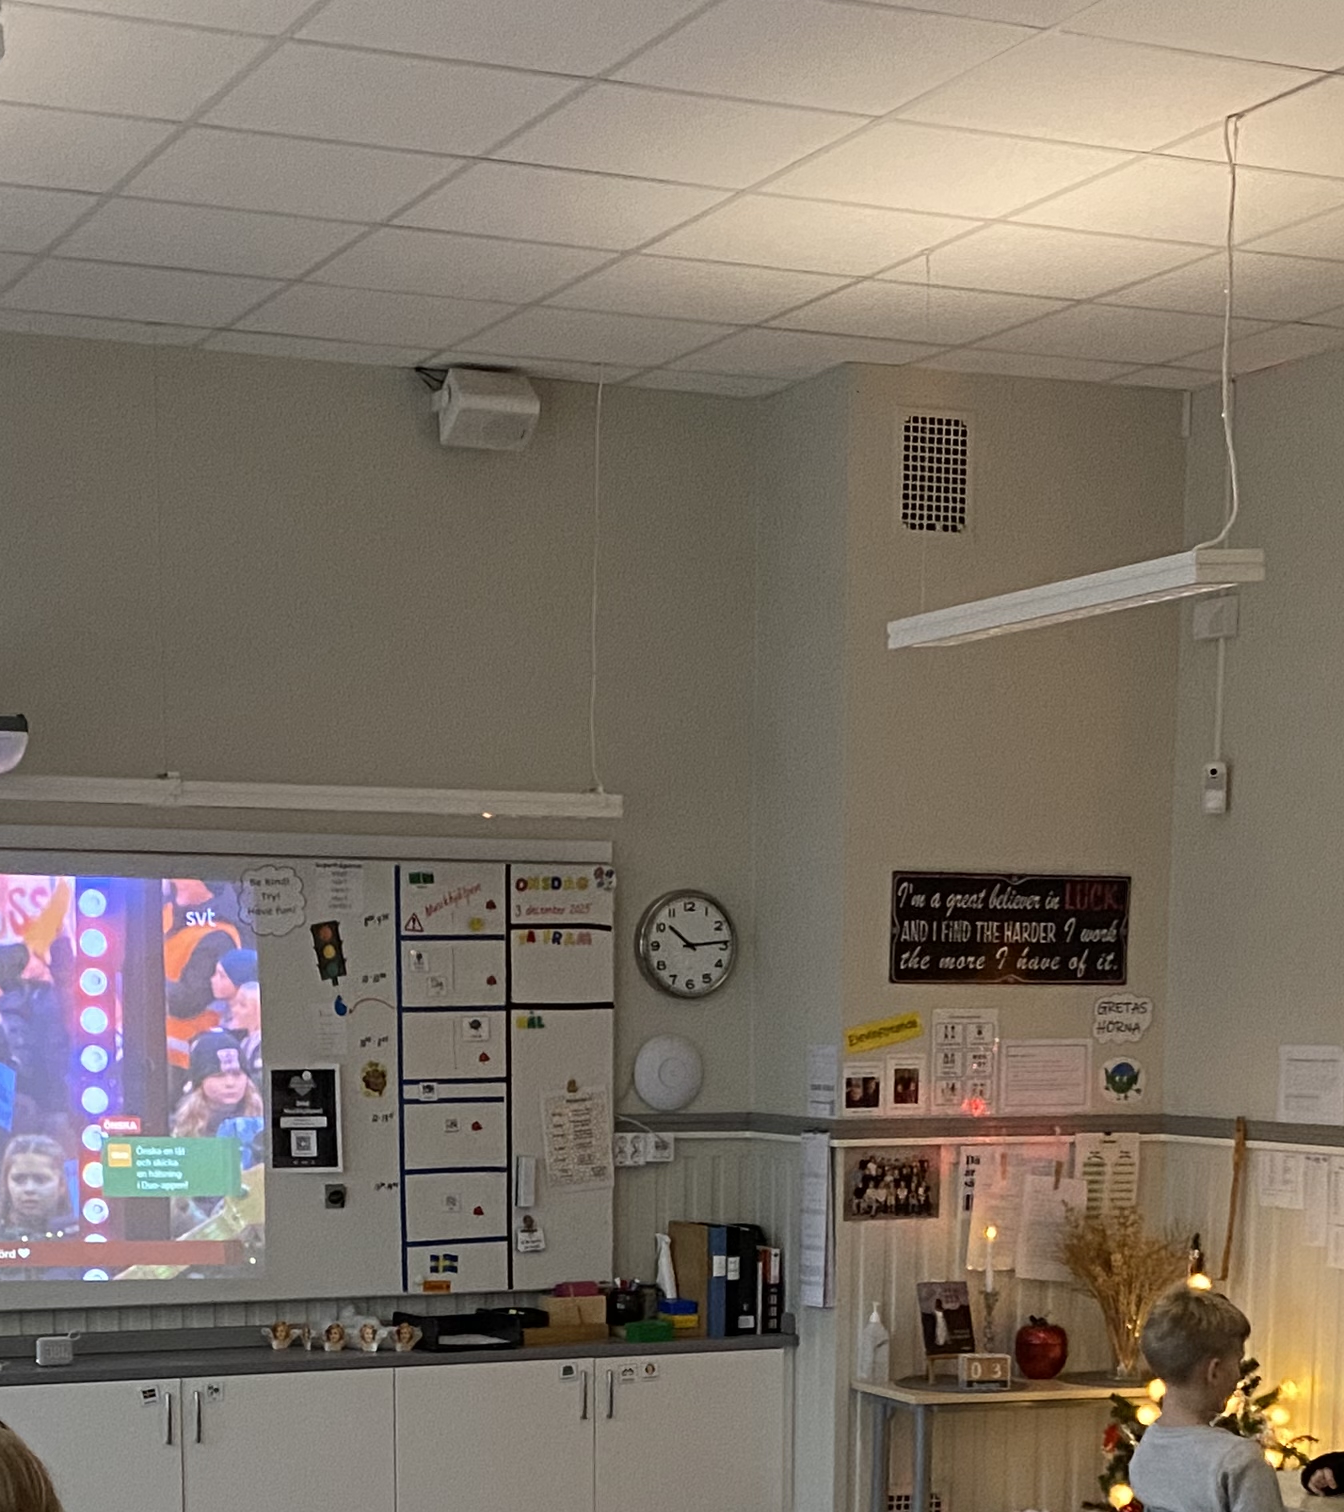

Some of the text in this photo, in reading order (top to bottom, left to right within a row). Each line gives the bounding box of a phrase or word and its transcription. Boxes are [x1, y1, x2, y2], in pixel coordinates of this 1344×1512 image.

[515, 876, 589, 892] ONSDAG
[897, 881, 925, 909] I'm
[930, 894, 942, 908] a
[945, 887, 987, 917] great
[988, 882, 1041, 911] believer
[1043, 891, 1061, 910] in
[515, 904, 522, 917] 3
[525, 904, 566, 916] december
[683, 901, 696, 912] 12
[185, 907, 217, 927] svt
[656, 922, 666, 933] 10
[714, 920, 723, 931] 2
[900, 919, 929, 943] AND
[932, 920, 938, 942] I
[975, 921, 1001, 944] THE
[1003, 921, 1057, 944] HARDER
[1063, 917, 1077, 943] I
[1079, 919, 1119, 944] work
[650, 940, 661, 951] 9
[656, 960, 666, 971] 8
[714, 958, 723, 968] 4
[899, 945, 1118, 978] the more I have of it.
[668, 974, 678, 985] 7
[702, 972, 712, 984] 5
[685, 979, 695, 990] 6
[1096, 1001, 1149, 1016] GRETAS
[1096, 1018, 1142, 1035] HÖRNA
[102, 1119, 138, 1131] ÖNSKA
[135, 1145, 162, 1156] Önska
[163, 1147, 174, 1156] en
[135, 1157, 180, 1167] och skicka
